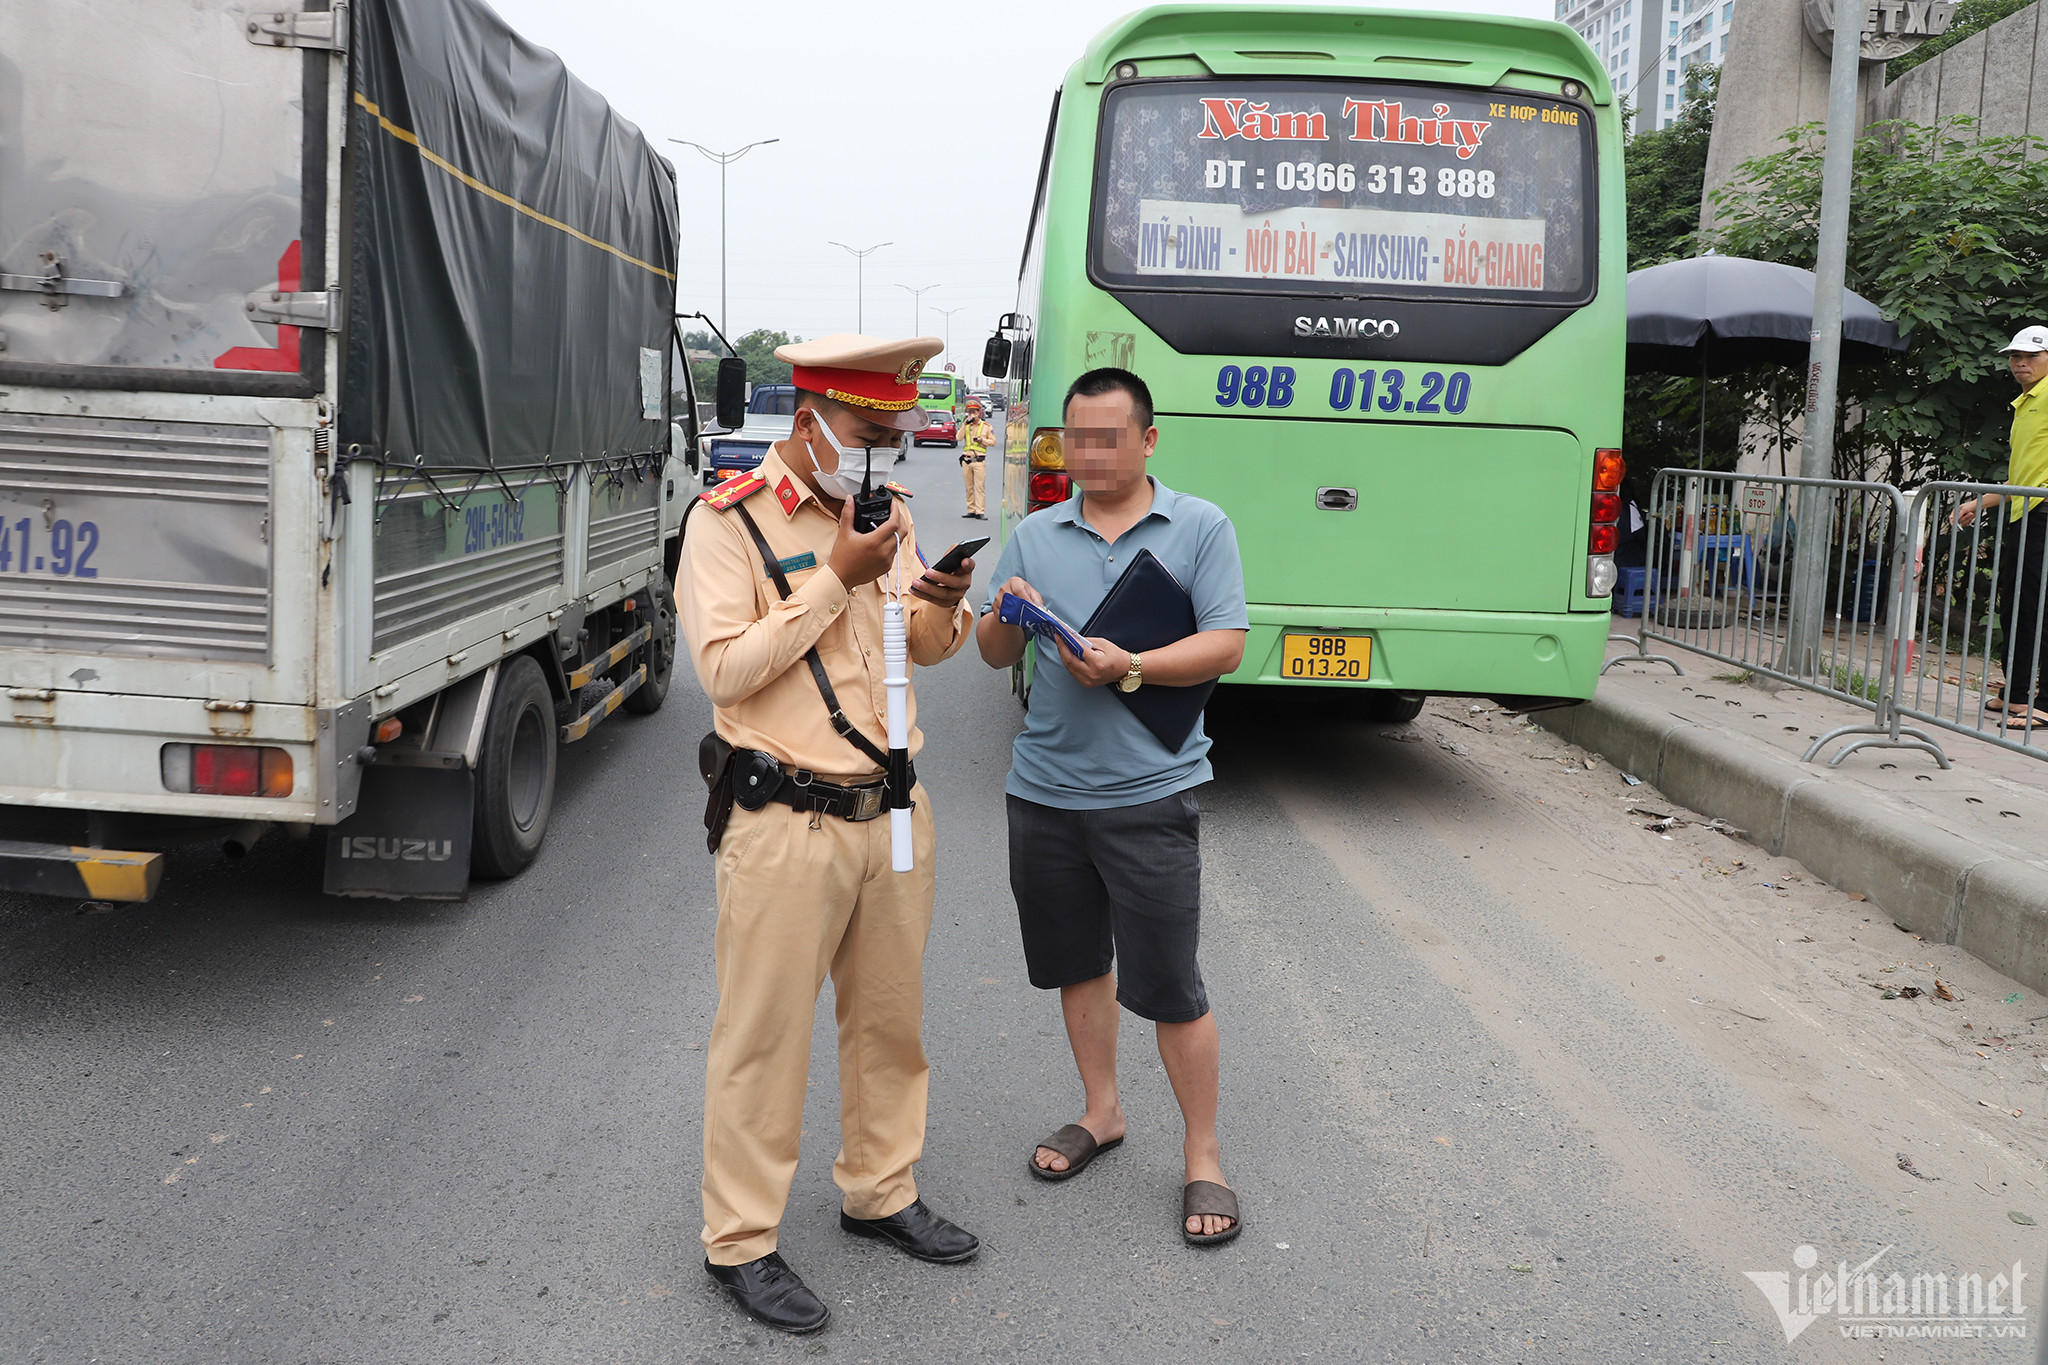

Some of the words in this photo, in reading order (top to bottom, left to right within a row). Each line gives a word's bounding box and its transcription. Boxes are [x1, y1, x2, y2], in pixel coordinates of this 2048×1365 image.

[1488, 102, 1506, 118] XE
[1510, 105, 1537, 123] HỢP
[1541, 104, 1579, 126] ĐỒNG
[1197, 97, 1330, 141] Năm
[1342, 96, 1491, 160] Thủy
[1204, 159, 1246, 189] ĐT
[1276, 161, 1356, 192] 0366
[1367, 164, 1427, 195] 313
[1437, 167, 1496, 199] 888
[1140, 215, 1171, 268] MỸ
[1175, 216, 1221, 271] ĐÌNH
[1245, 219, 1279, 279] NỘI
[1284, 221, 1316, 275] BÀI
[1333, 232, 1428, 282] SAMSUNG
[1443, 223, 1480, 285] BẮC
[1485, 241, 1542, 288] GIANG
[1294, 316, 1400, 341] SAMCO
[1215, 365, 1297, 408] 98B
[1328, 367, 1472, 415] 013.20
[1748, 498, 1766, 509] STOP
[1309, 637, 1346, 656] 98B
[1292, 657, 1360, 677] 013.20
[341, 836, 452, 861] ISUZU
